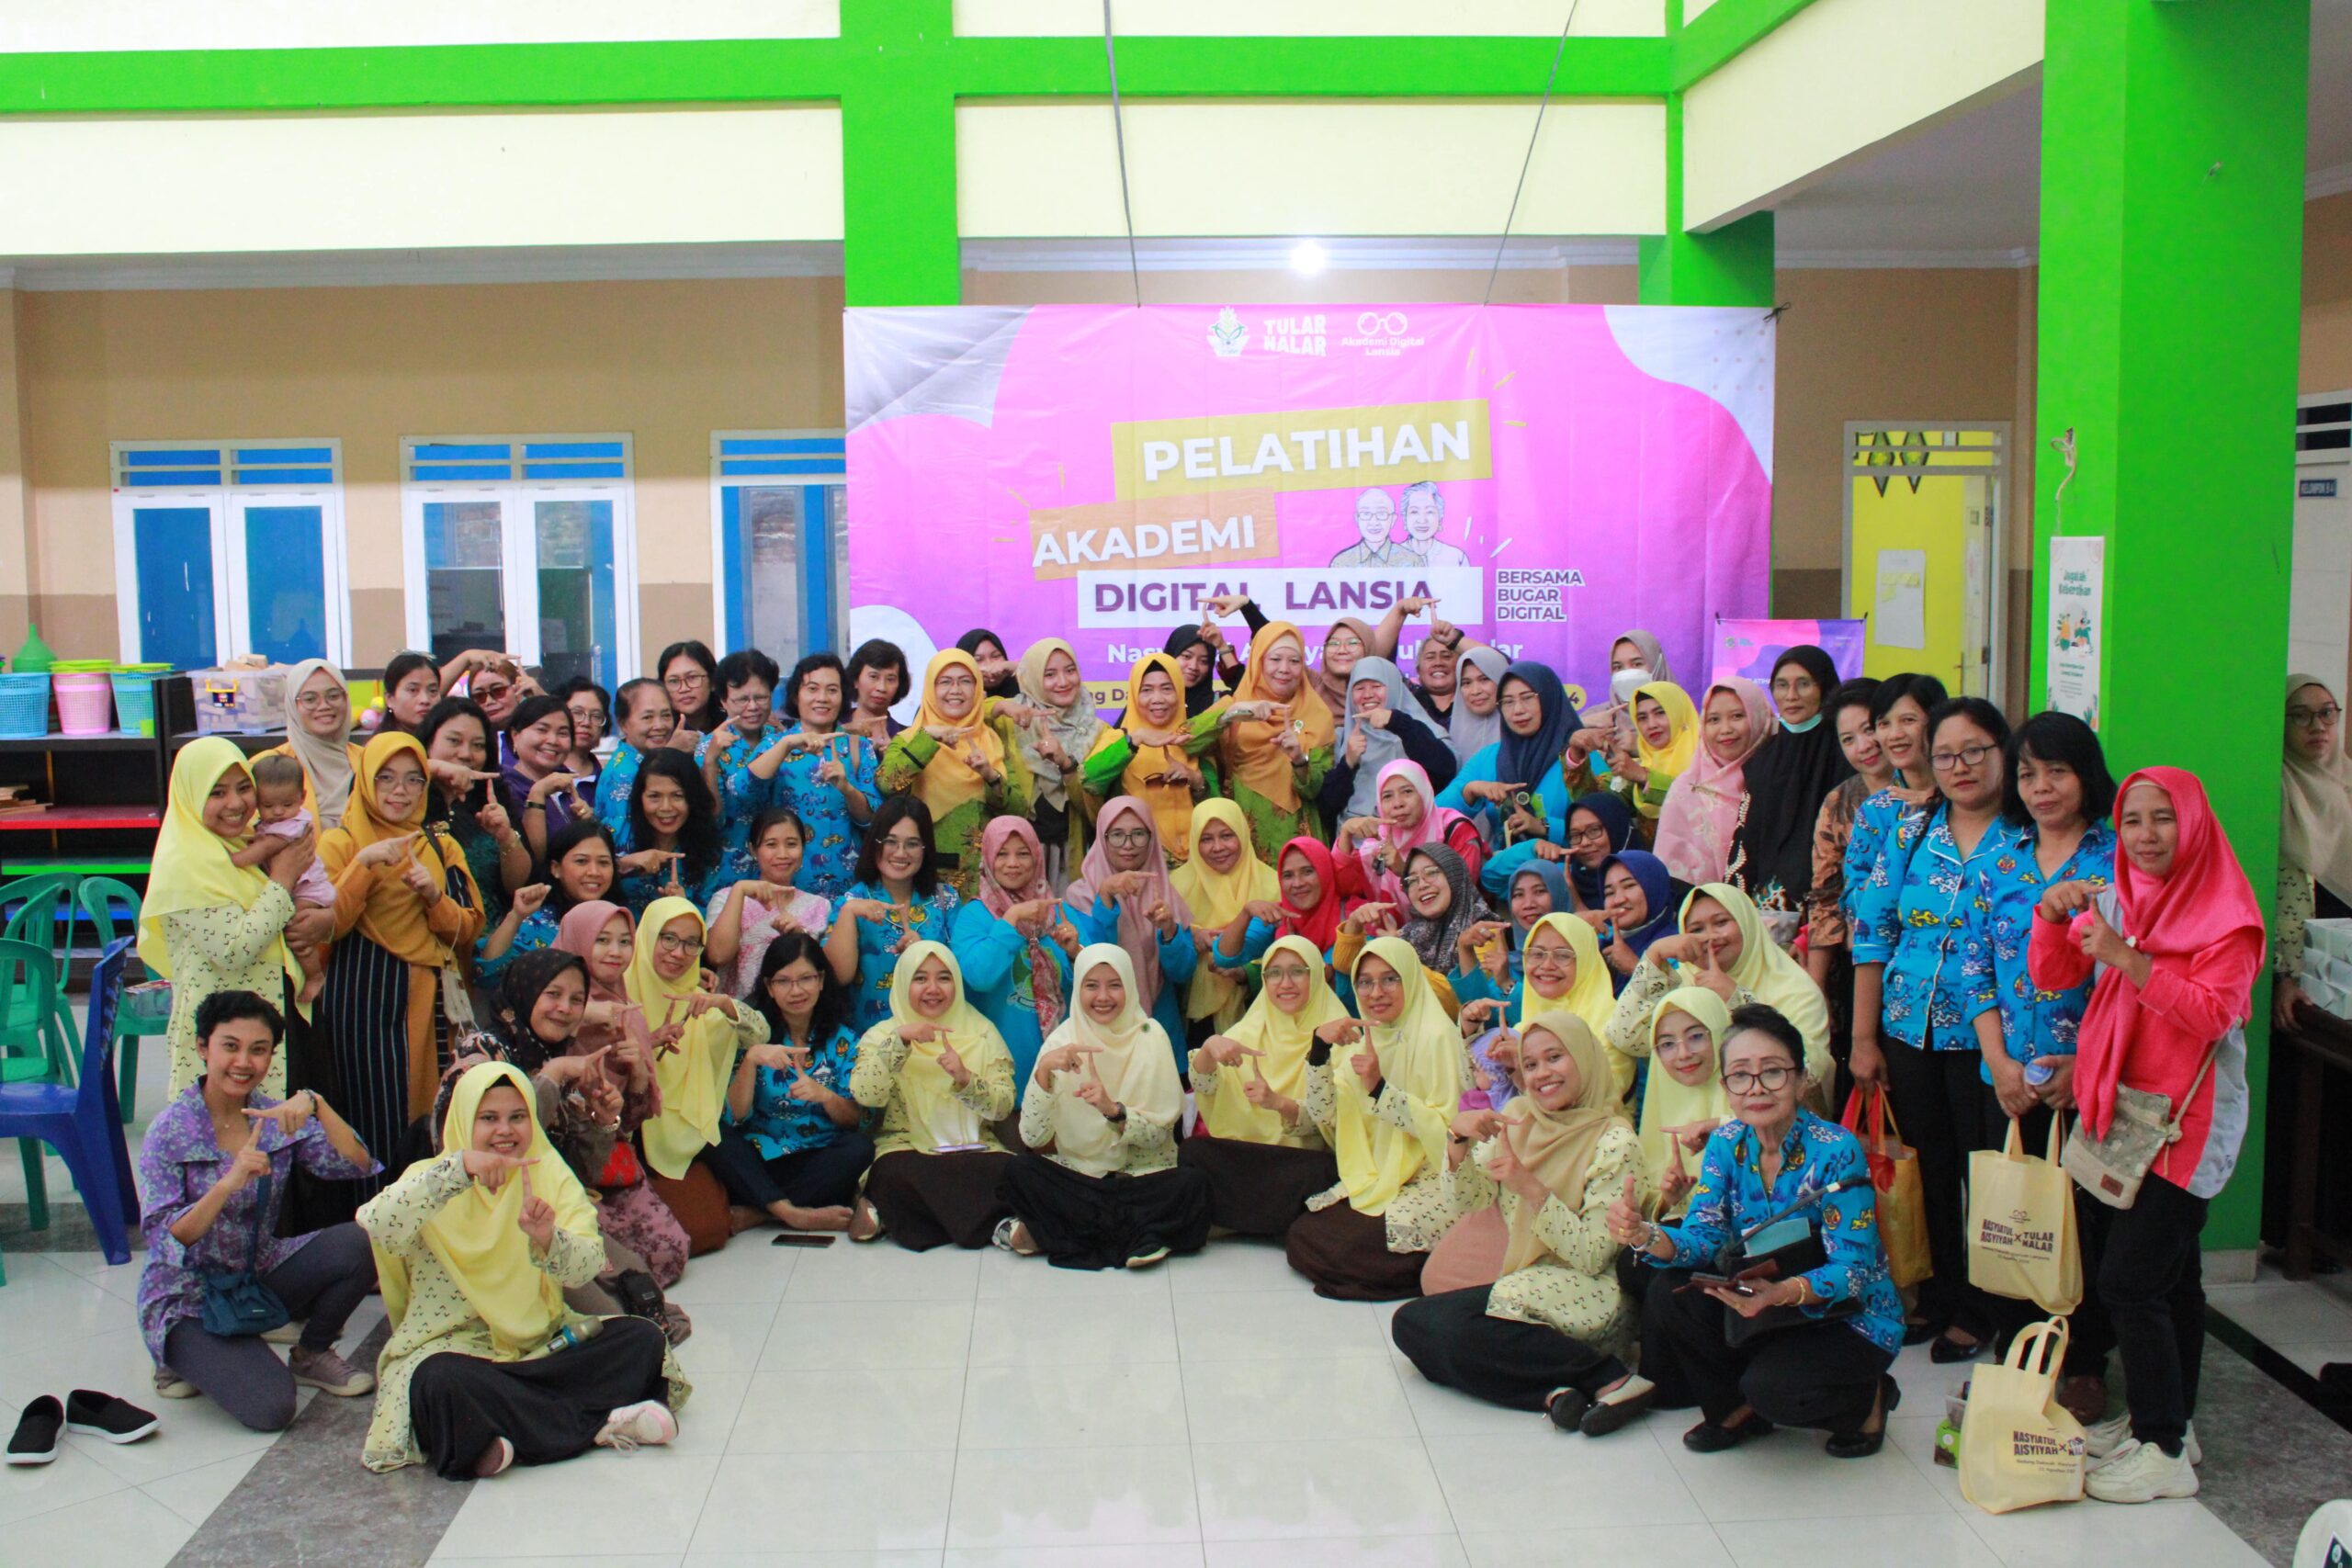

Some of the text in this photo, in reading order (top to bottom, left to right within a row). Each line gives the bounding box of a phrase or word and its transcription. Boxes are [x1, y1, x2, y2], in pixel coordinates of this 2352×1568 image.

[1263, 314, 1327, 335] TULAR
[1263, 335, 1327, 356] NALAR
[1341, 337, 1424, 349] Akademi Digital
[1142, 420, 1471, 482] PELATIHAN
[1032, 515, 1256, 568] AKADEMI
[1497, 570, 1583, 584] BERSAMA
[1497, 588, 1559, 602] BUGAR
[1497, 606, 1566, 619] DIGITAL
[2023, 1232, 2054, 1242] TULAR
